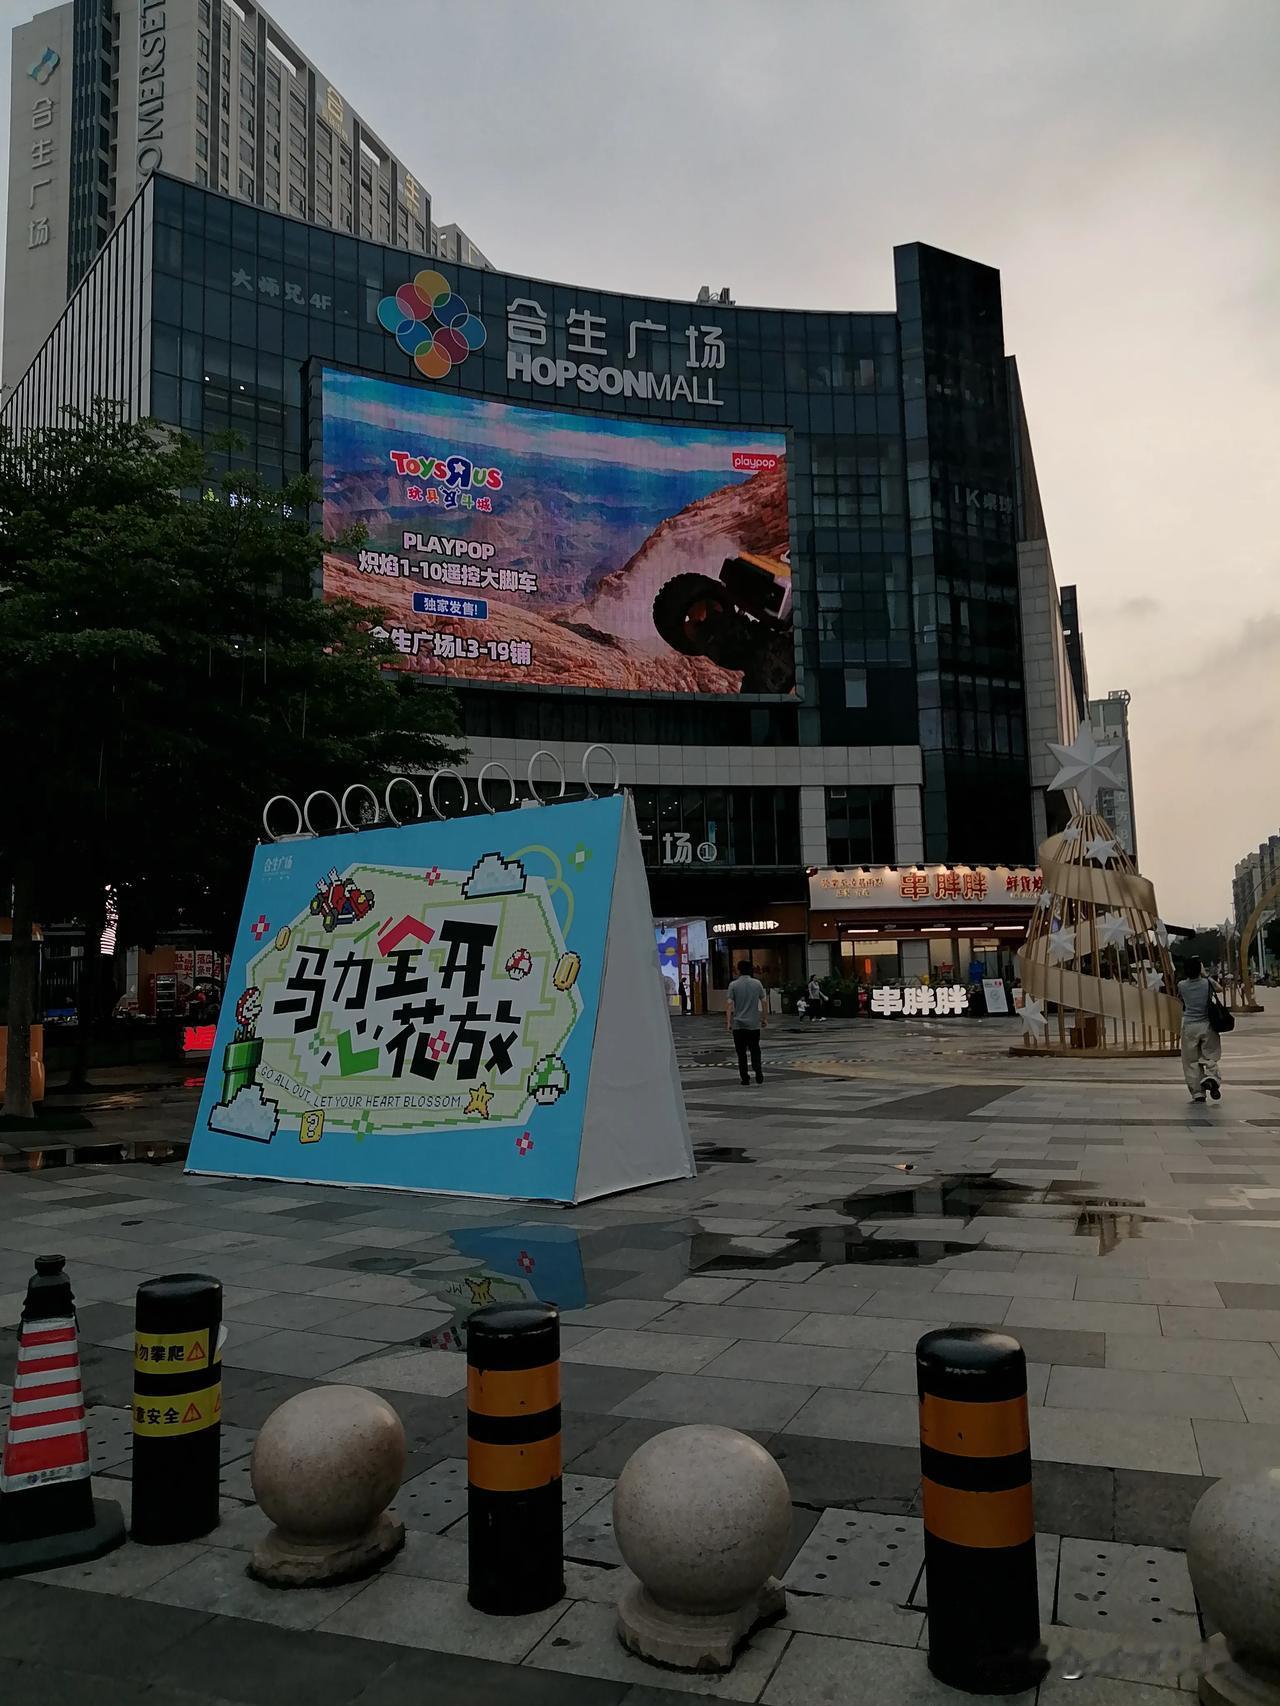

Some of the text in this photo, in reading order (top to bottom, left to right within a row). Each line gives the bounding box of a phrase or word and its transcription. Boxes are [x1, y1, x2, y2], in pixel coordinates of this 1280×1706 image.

[137, 0, 167, 188] OMERSET
[27, 97, 54, 249] 合生广场
[309, 292, 332, 311] 4F
[507, 297, 726, 369] 合生广场
[734, 454, 776, 469] playpop
[402, 532, 496, 561] PLAYPOP
[357, 550, 539, 594] 炽焰1-10遥控大脚车
[900, 871, 988, 901] 串胖胖
[273, 914, 498, 1034] 马力全开
[871, 984, 969, 1016] 串胖胖
[260, 1065, 273, 1079] GO
[273, 1073, 290, 1091] ALL
[314, 1096, 333, 1108] LET
[335, 1096, 362, 1108] YOUR
[366, 1096, 401, 1108] HEART
[403, 1095, 464, 1108] BLOSSOM.
